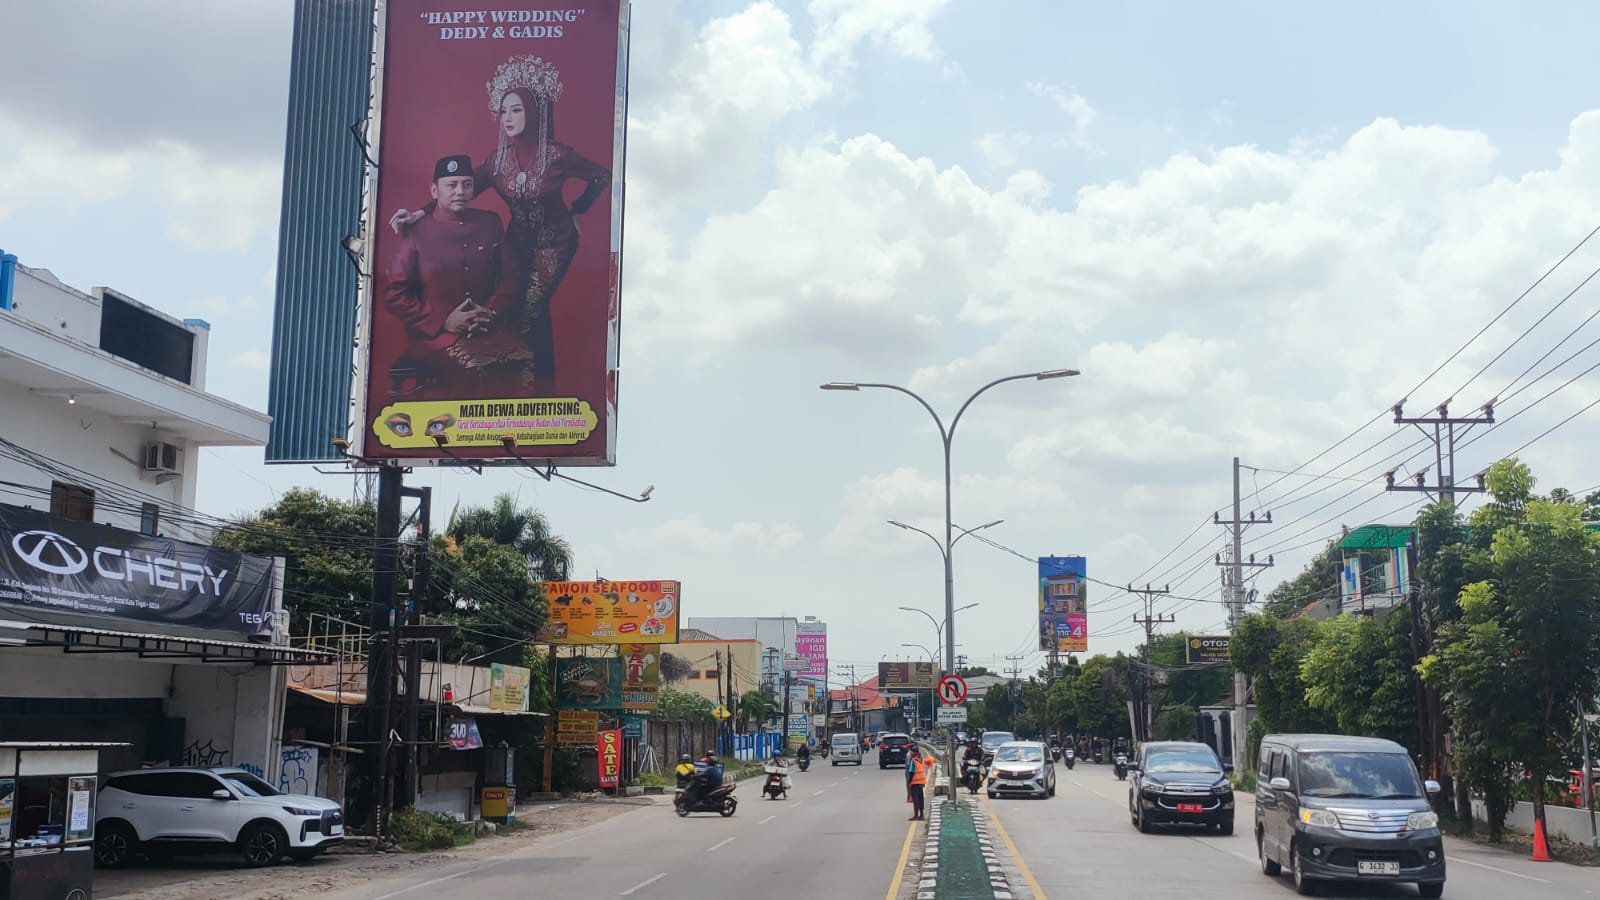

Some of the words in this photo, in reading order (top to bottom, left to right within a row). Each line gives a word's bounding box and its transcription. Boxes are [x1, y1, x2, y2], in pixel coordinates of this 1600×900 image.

[439, 26, 489, 40] DEDY
[492, 26, 505, 39] &
[509, 25, 564, 38] GADIS
[459, 404, 485, 417] MATA
[487, 403, 514, 416] DEWA
[516, 401, 582, 416] ADVERTISING.
[93, 545, 228, 597] CHERY
[592, 582, 658, 593] SEAFOOD
[1073, 625, 1082, 636] 4
[796, 637, 825, 645] ayanan
[603, 733, 617, 776] SATE
